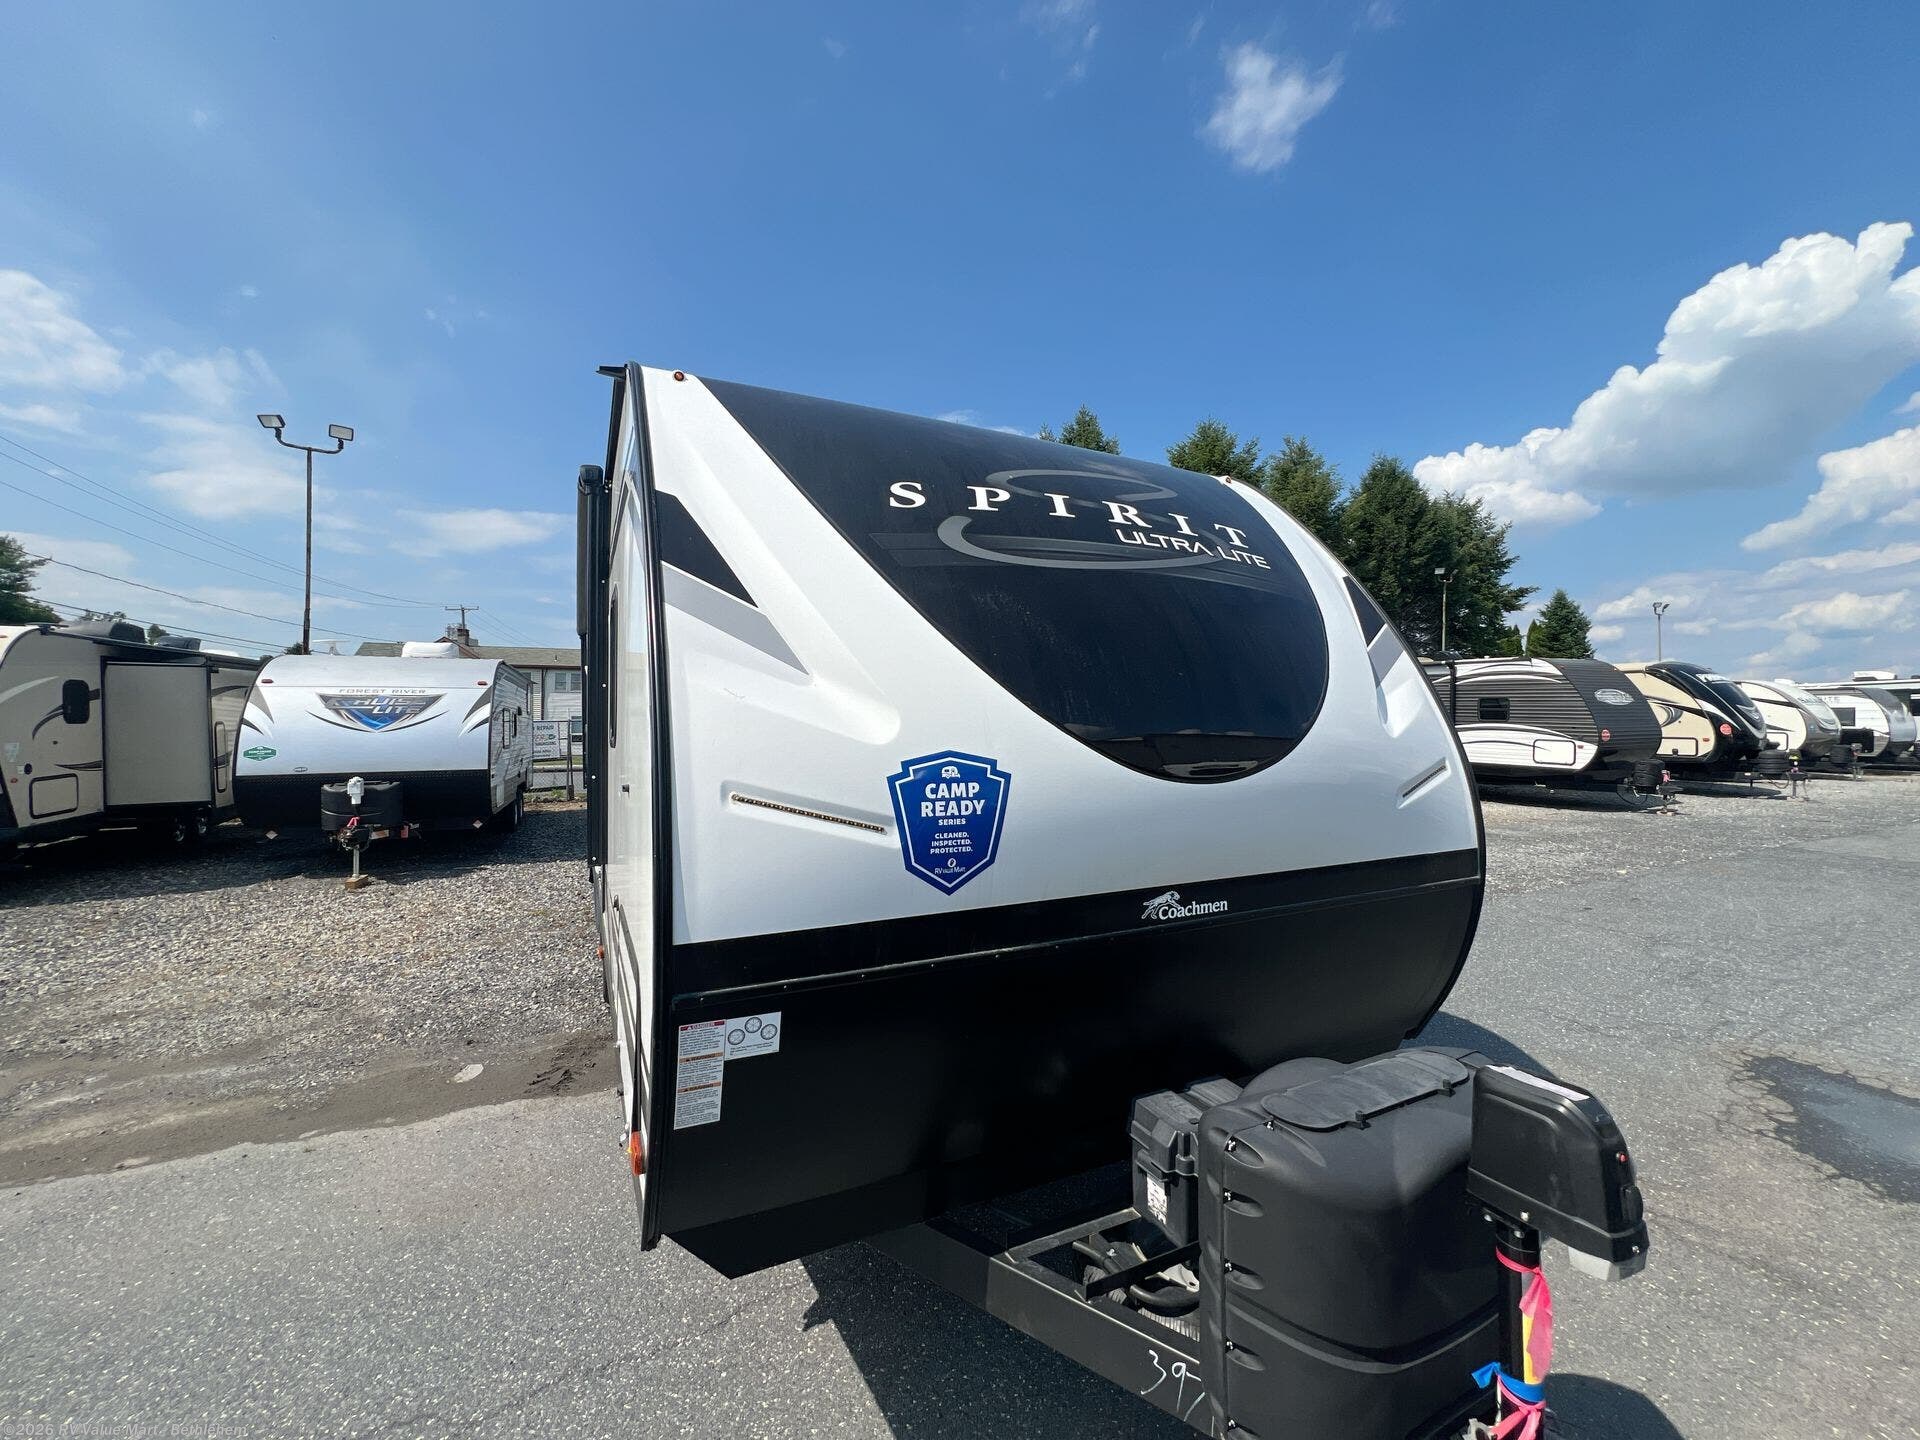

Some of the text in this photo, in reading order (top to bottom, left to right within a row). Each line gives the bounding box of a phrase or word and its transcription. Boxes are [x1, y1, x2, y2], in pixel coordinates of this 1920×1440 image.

[888, 481, 1249, 549] SPIRIT
[1115, 528, 1272, 570] ULTRA LITE
[925, 782, 980, 799] CAMP
[921, 800, 985, 817] READY
[938, 818, 966, 826] SERIES
[930, 847, 973, 855] PROTECTED.
[931, 839, 972, 847] INSPECTED.
[1159, 901, 1228, 920] Coachmen
